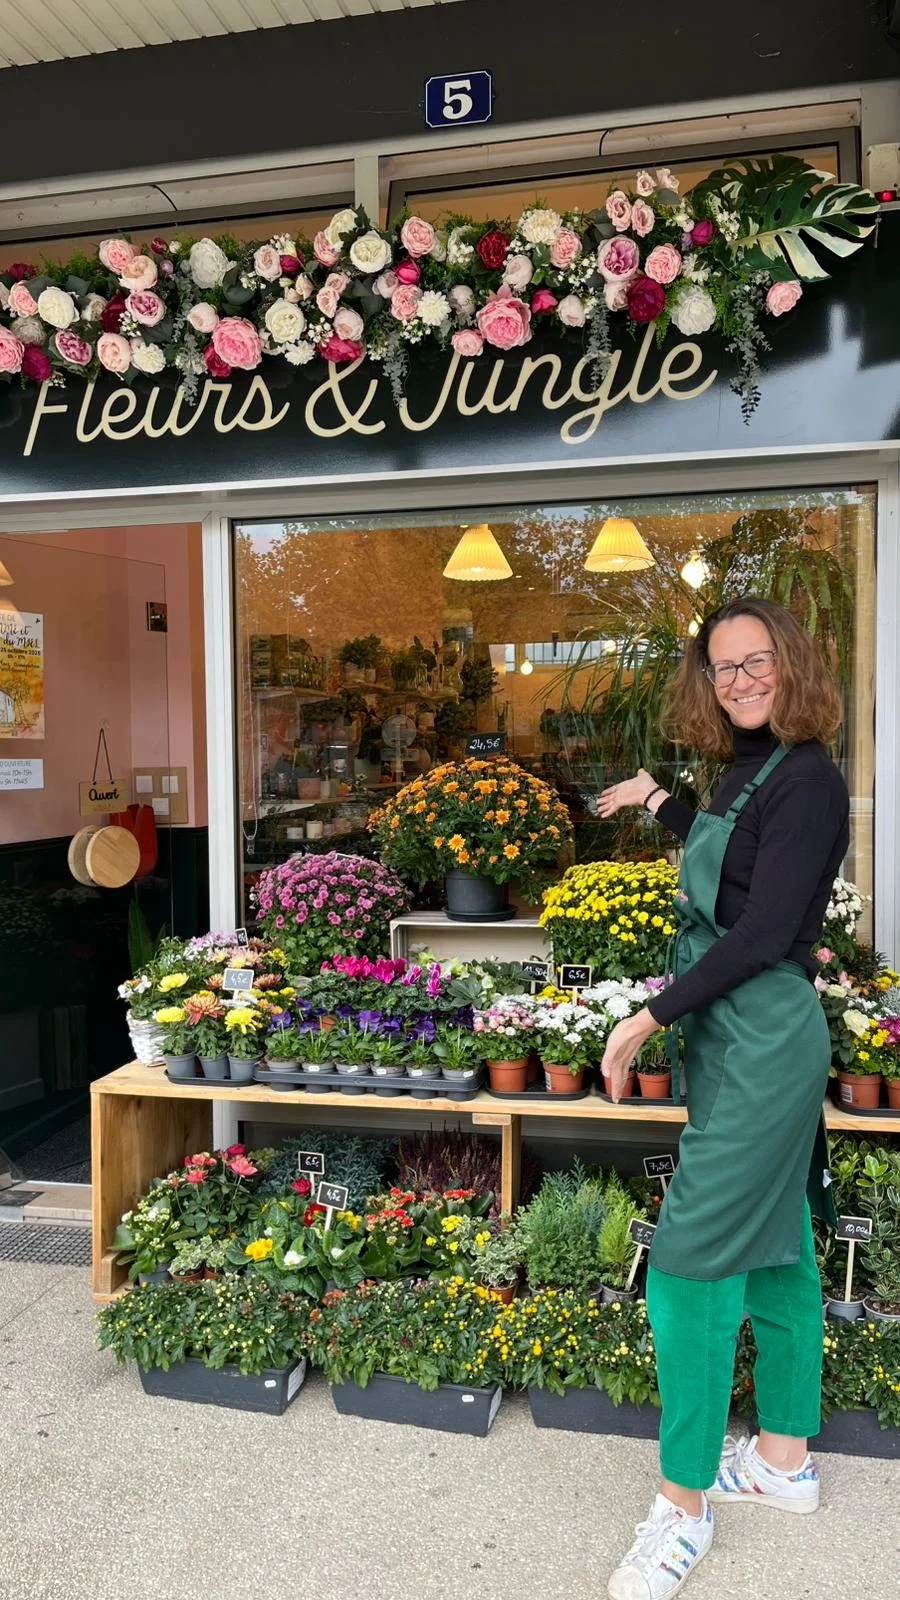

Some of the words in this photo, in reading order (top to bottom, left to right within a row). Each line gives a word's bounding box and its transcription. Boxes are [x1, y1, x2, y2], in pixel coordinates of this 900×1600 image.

[443, 79, 473, 120] 5
[305, 357, 386, 437] &
[399, 321, 718, 445] Jungle
[469, 737, 501, 750] 24,5€
[88, 788, 120, 802] Ouvert
[523, 965, 548, 979] 1150€
[648, 1161, 673, 1173] 7,5€
